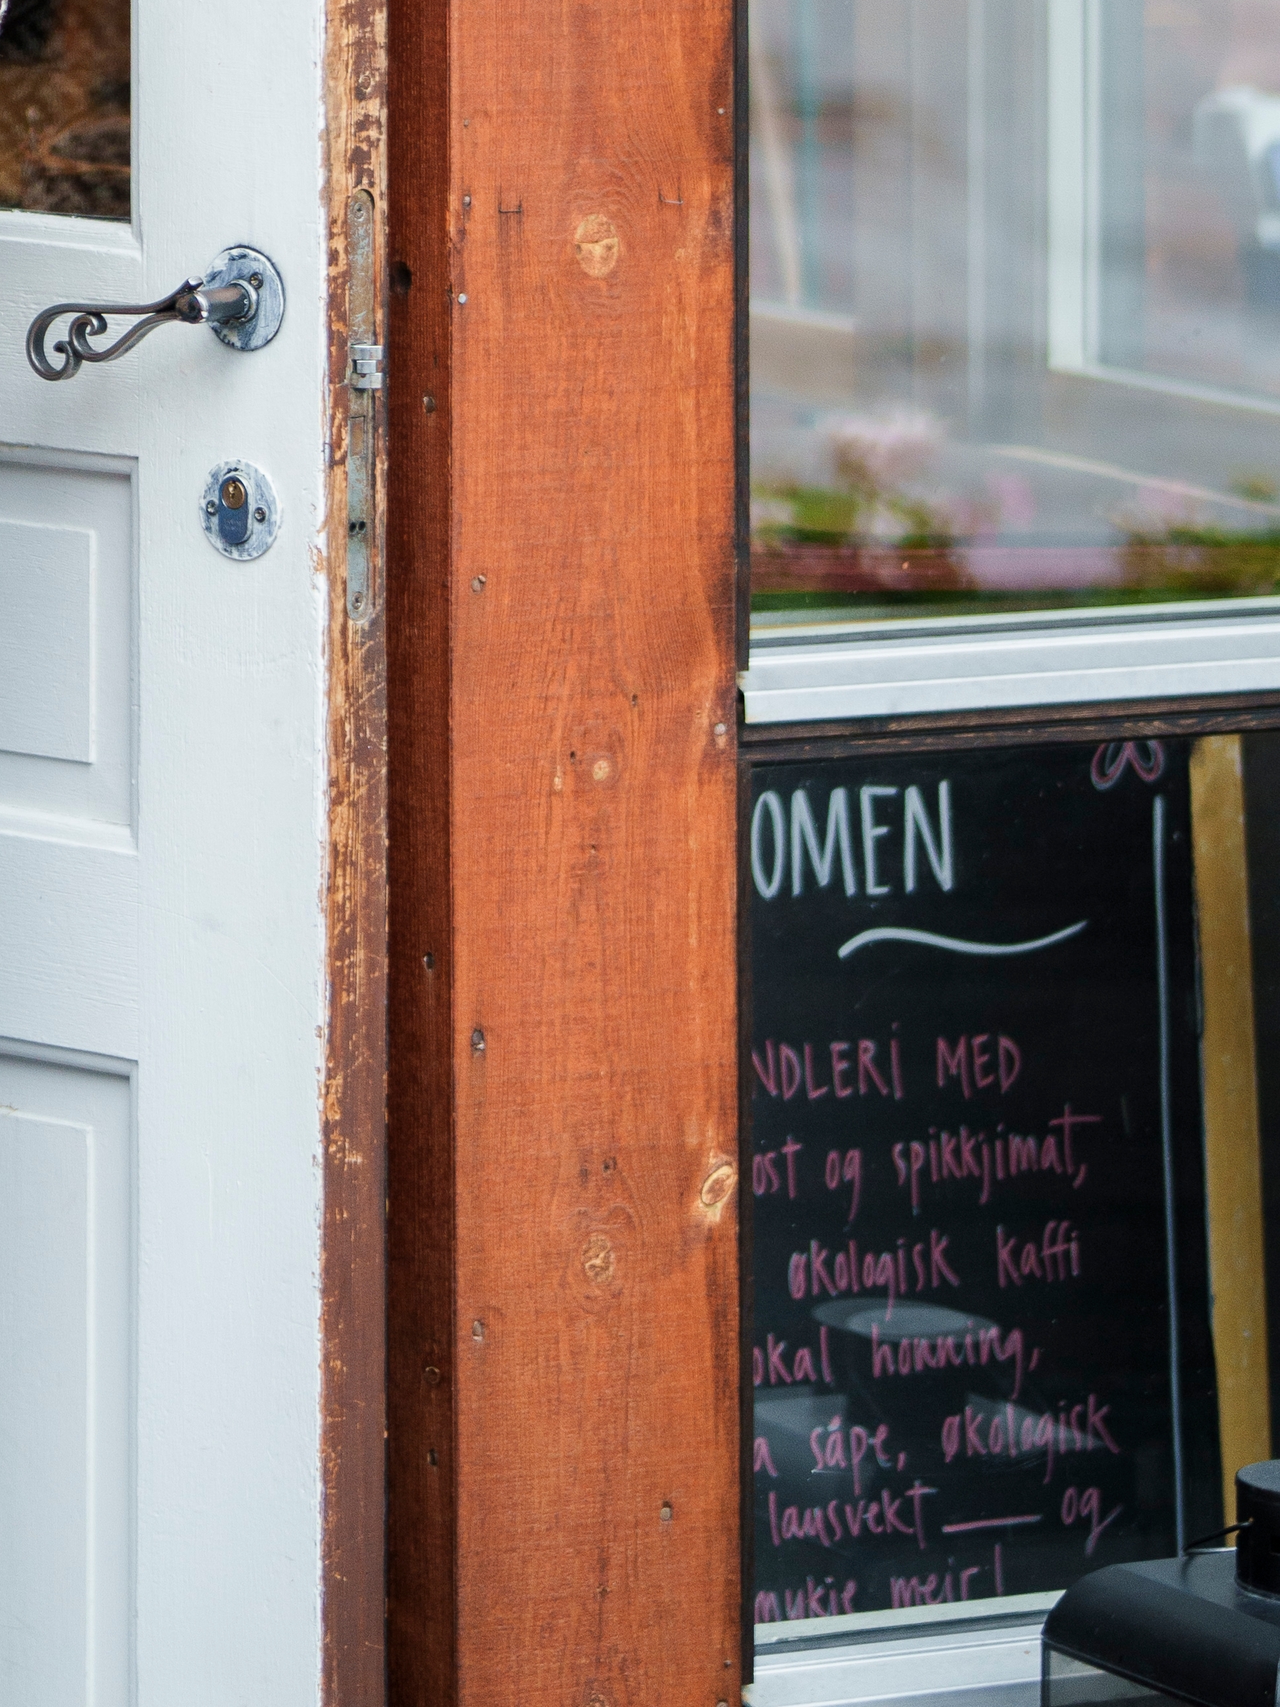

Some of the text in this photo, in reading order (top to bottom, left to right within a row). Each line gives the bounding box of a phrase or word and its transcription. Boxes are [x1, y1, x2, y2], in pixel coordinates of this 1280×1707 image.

[750, 778, 955, 899] OMEN
[935, 1033, 1022, 1101] MED
[825, 1147, 862, 1224] og
[996, 1219, 1081, 1288] kaffi
[1060, 1486, 1124, 1558] og
